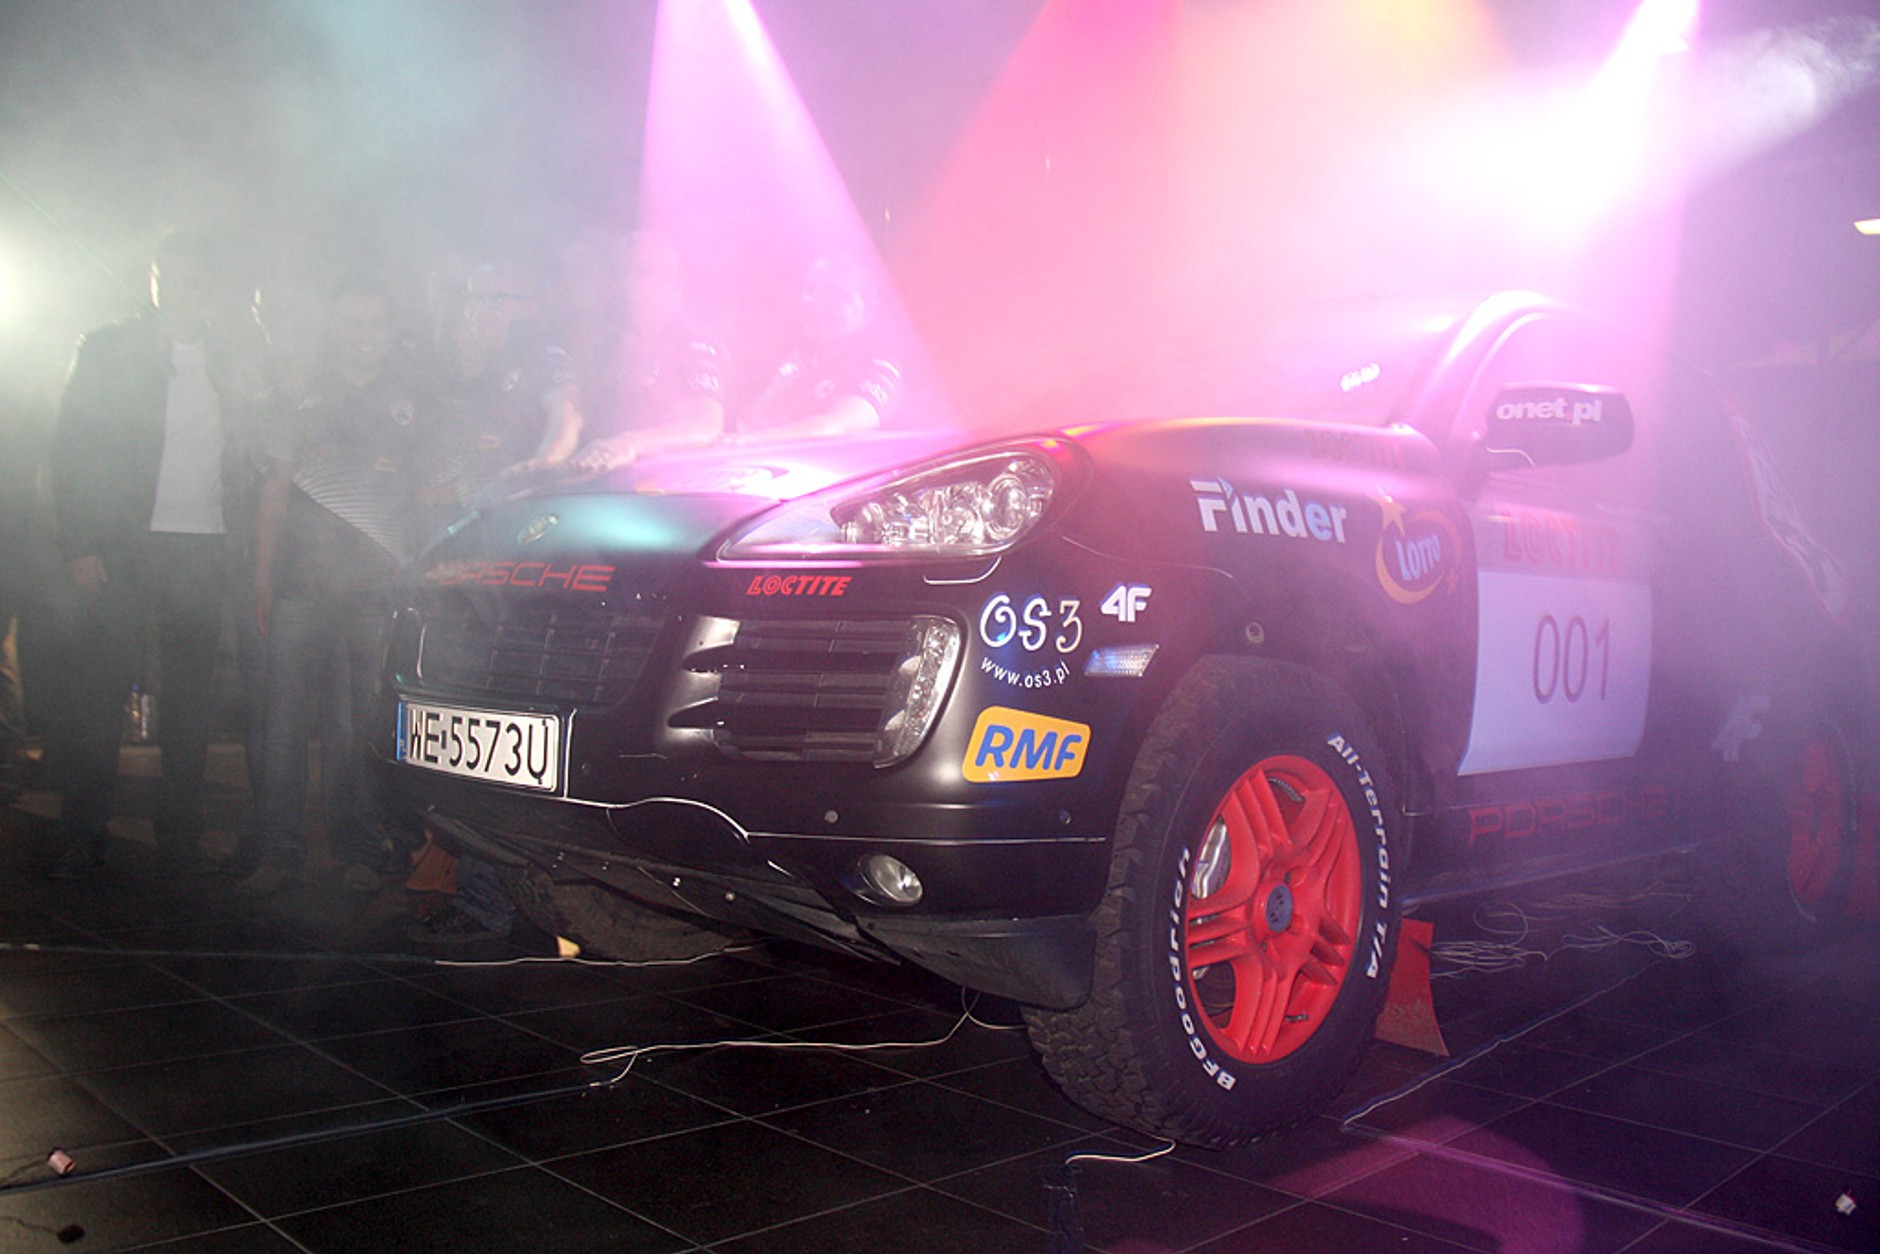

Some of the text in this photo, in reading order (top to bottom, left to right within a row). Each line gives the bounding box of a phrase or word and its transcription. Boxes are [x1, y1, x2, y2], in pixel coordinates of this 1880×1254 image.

[1189, 477, 1347, 543] Finder
[424, 561, 616, 592] ORSCHE
[746, 575, 853, 596] LOCTITE
[1101, 584, 1152, 622] 4F
[980, 655, 1071, 689] www.os3.pl
[1532, 613, 1611, 704] 001
[975, 724, 1083, 771] RMF
